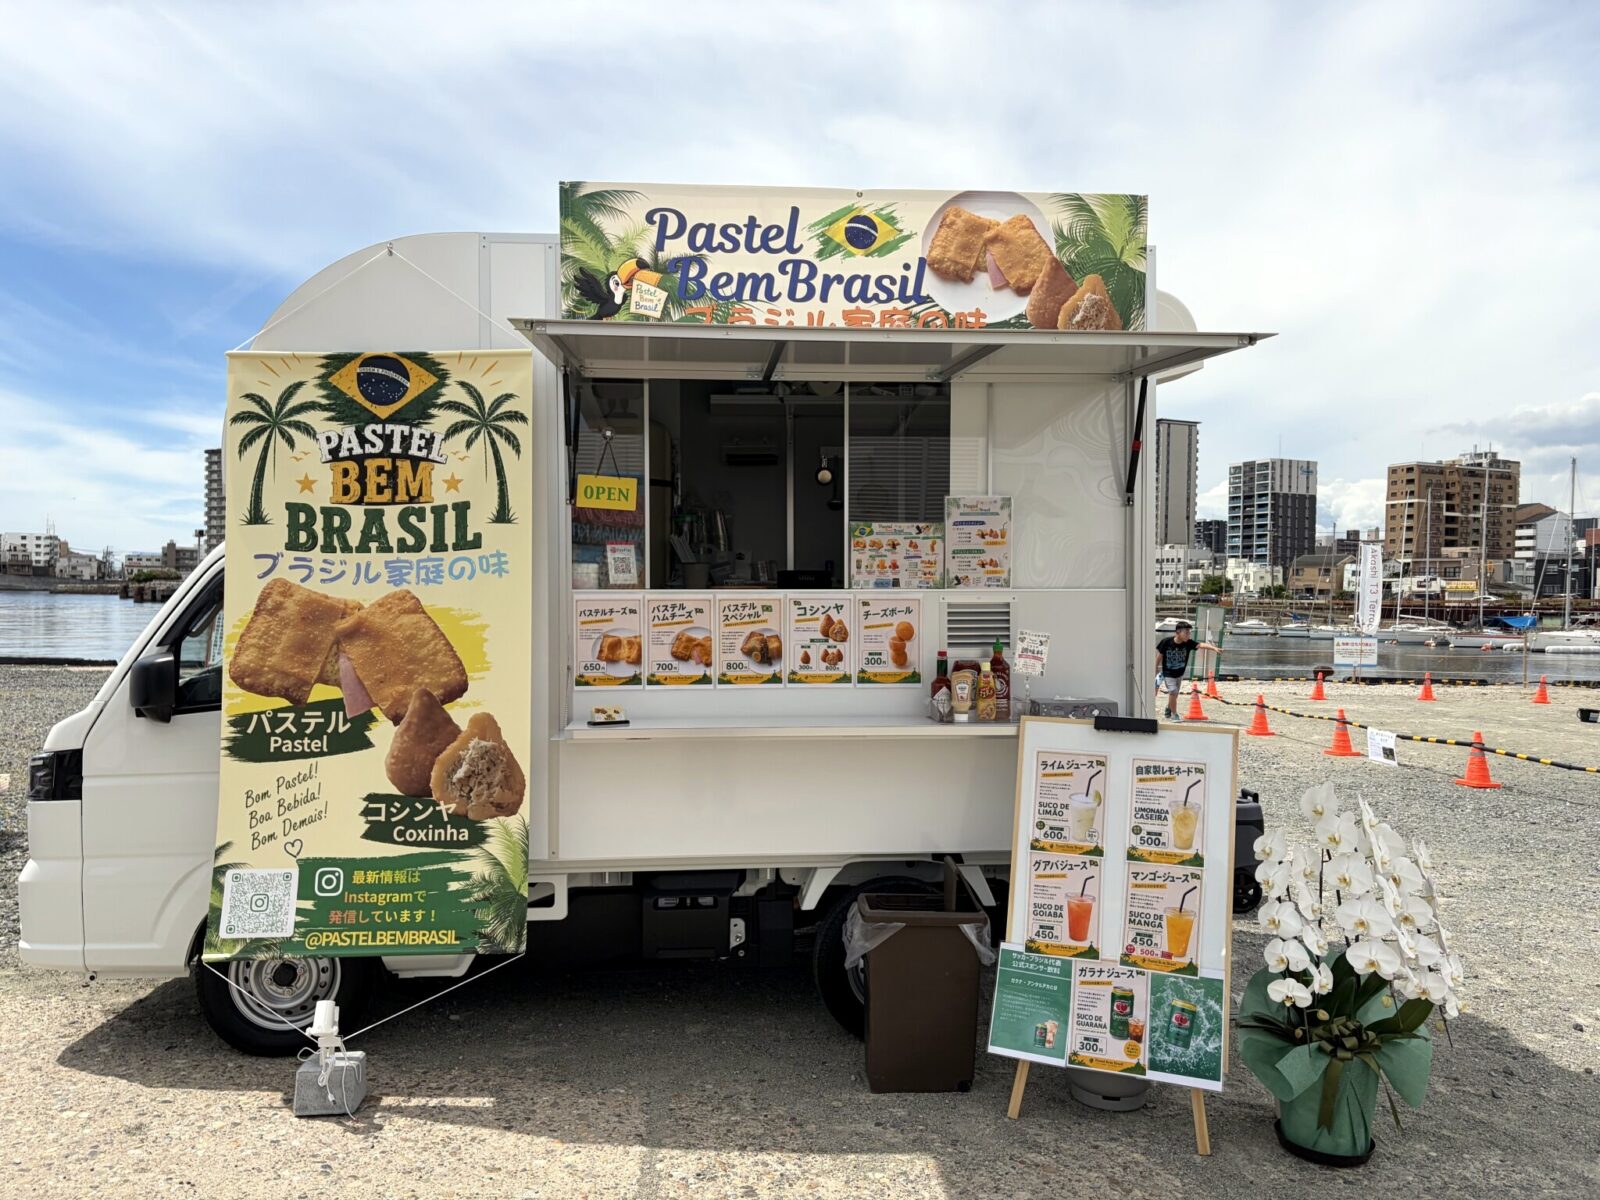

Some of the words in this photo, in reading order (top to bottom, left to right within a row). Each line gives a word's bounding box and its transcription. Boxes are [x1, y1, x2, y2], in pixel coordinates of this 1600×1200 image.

[645, 206, 803, 254] Pastel
[636, 284, 657, 297] Pastel
[635, 301, 659, 312] Brasil
[316, 423, 448, 464] PASTEL
[330, 458, 434, 505] BEM
[583, 485, 630, 502] OPEN
[285, 501, 482, 554] BRASIL
[253, 550, 510, 586] ブラジル家庭の味
[1369, 547, 1379, 579] Akashi
[1369, 583, 1379, 595] T3
[579, 606, 629, 617] パステルチーズ
[652, 603, 686, 614] パステル
[722, 602, 757, 613] パステル
[797, 603, 844, 616] コシンヤ
[863, 606, 913, 620] チーズボール
[652, 610, 693, 622] ハムチーズ
[722, 610, 761, 622] スペシャル
[247, 711, 352, 735] パステル
[269, 736, 328, 752] Pastel
[1040, 760, 1095, 771] ライムジュース
[1136, 765, 1193, 776] 自家製レモネード
[245, 788, 271, 809] Bom
[276, 761, 318, 793] Pastel!
[249, 810, 272, 829] Boa
[277, 783, 321, 816] Bebida!
[367, 801, 457, 822] コシンヤ
[1038, 801, 1059, 809] SUCO
[1134, 807, 1169, 815] LIMONADA
[1037, 808, 1064, 817] LIMÃO
[1134, 813, 1169, 822] CASEIRA
[251, 831, 277, 850] Bom
[283, 801, 328, 837] Demais!
[393, 825, 469, 842] Coxinha
[1033, 859, 1088, 872] グアバジュース
[352, 870, 421, 884] 最新情報は
[1131, 870, 1190, 883] マンゴージュース
[344, 890, 427, 905] Instagramで
[1033, 902, 1053, 910] SUCO
[1054, 904, 1064, 912] DE
[328, 910, 436, 924] 発信しています！
[1032, 910, 1064, 918] GOIABA
[1129, 911, 1151, 919] SUCO
[1153, 913, 1164, 921] DE
[1128, 918, 1164, 929] MANGA
[305, 930, 460, 949] @PASTELBEMBRASIL
[1078, 967, 1135, 979] ガラナジュース
[1076, 1013, 1093, 1021] SUCO
[1076, 1020, 1107, 1030] GUARANÁ
